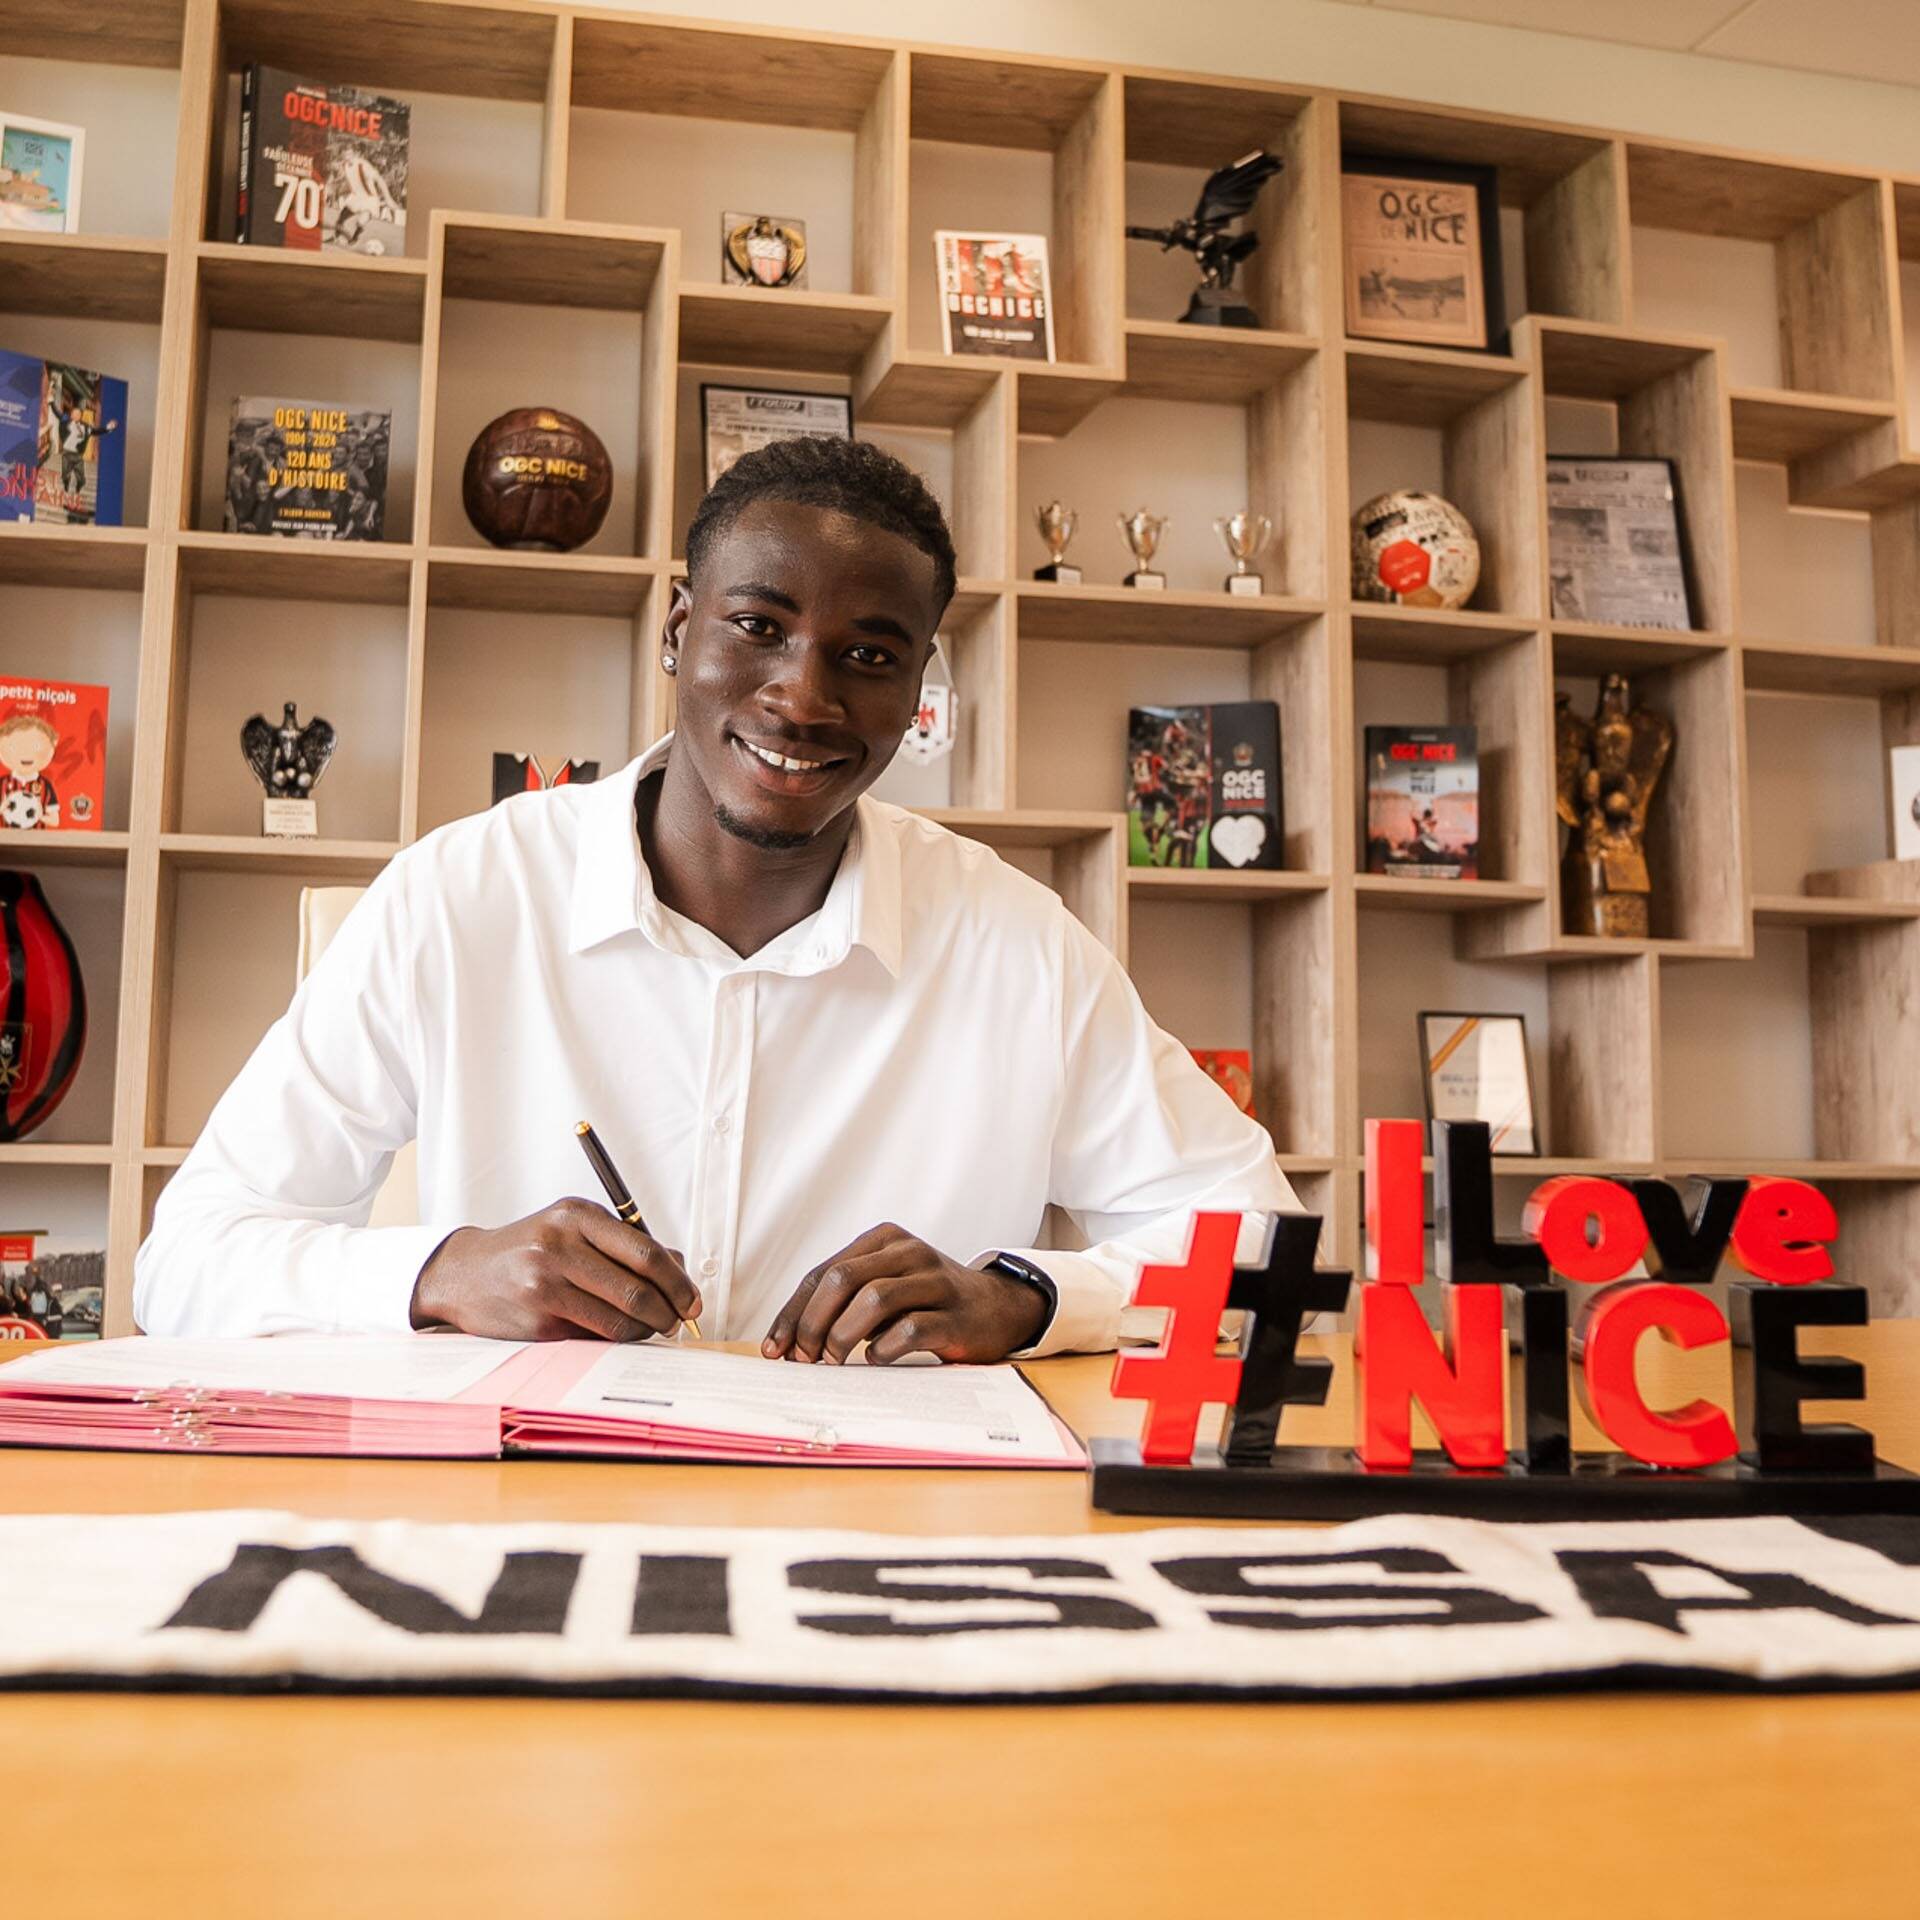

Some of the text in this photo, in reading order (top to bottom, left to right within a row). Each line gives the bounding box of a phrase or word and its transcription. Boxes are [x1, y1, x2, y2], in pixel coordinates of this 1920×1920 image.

[1405, 211, 1468, 246] NICE
[274, 407, 349, 433] OGC NICE
[312, 432, 338, 448] 2024
[286, 451, 333, 470] 120 ANS
[499, 455, 545, 474] OGC
[545, 457, 589, 481] NICE
[268, 467, 348, 491] D'HISTOIRE
[0, 685, 77, 706] petit niçois
[1222, 769, 1265, 788] OGC
[1222, 786, 1266, 800] NICE
[1364, 1118, 1839, 1286] I Love
[1354, 1280, 1875, 1472] NICE
[155, 1543, 1920, 1636] NISSA
